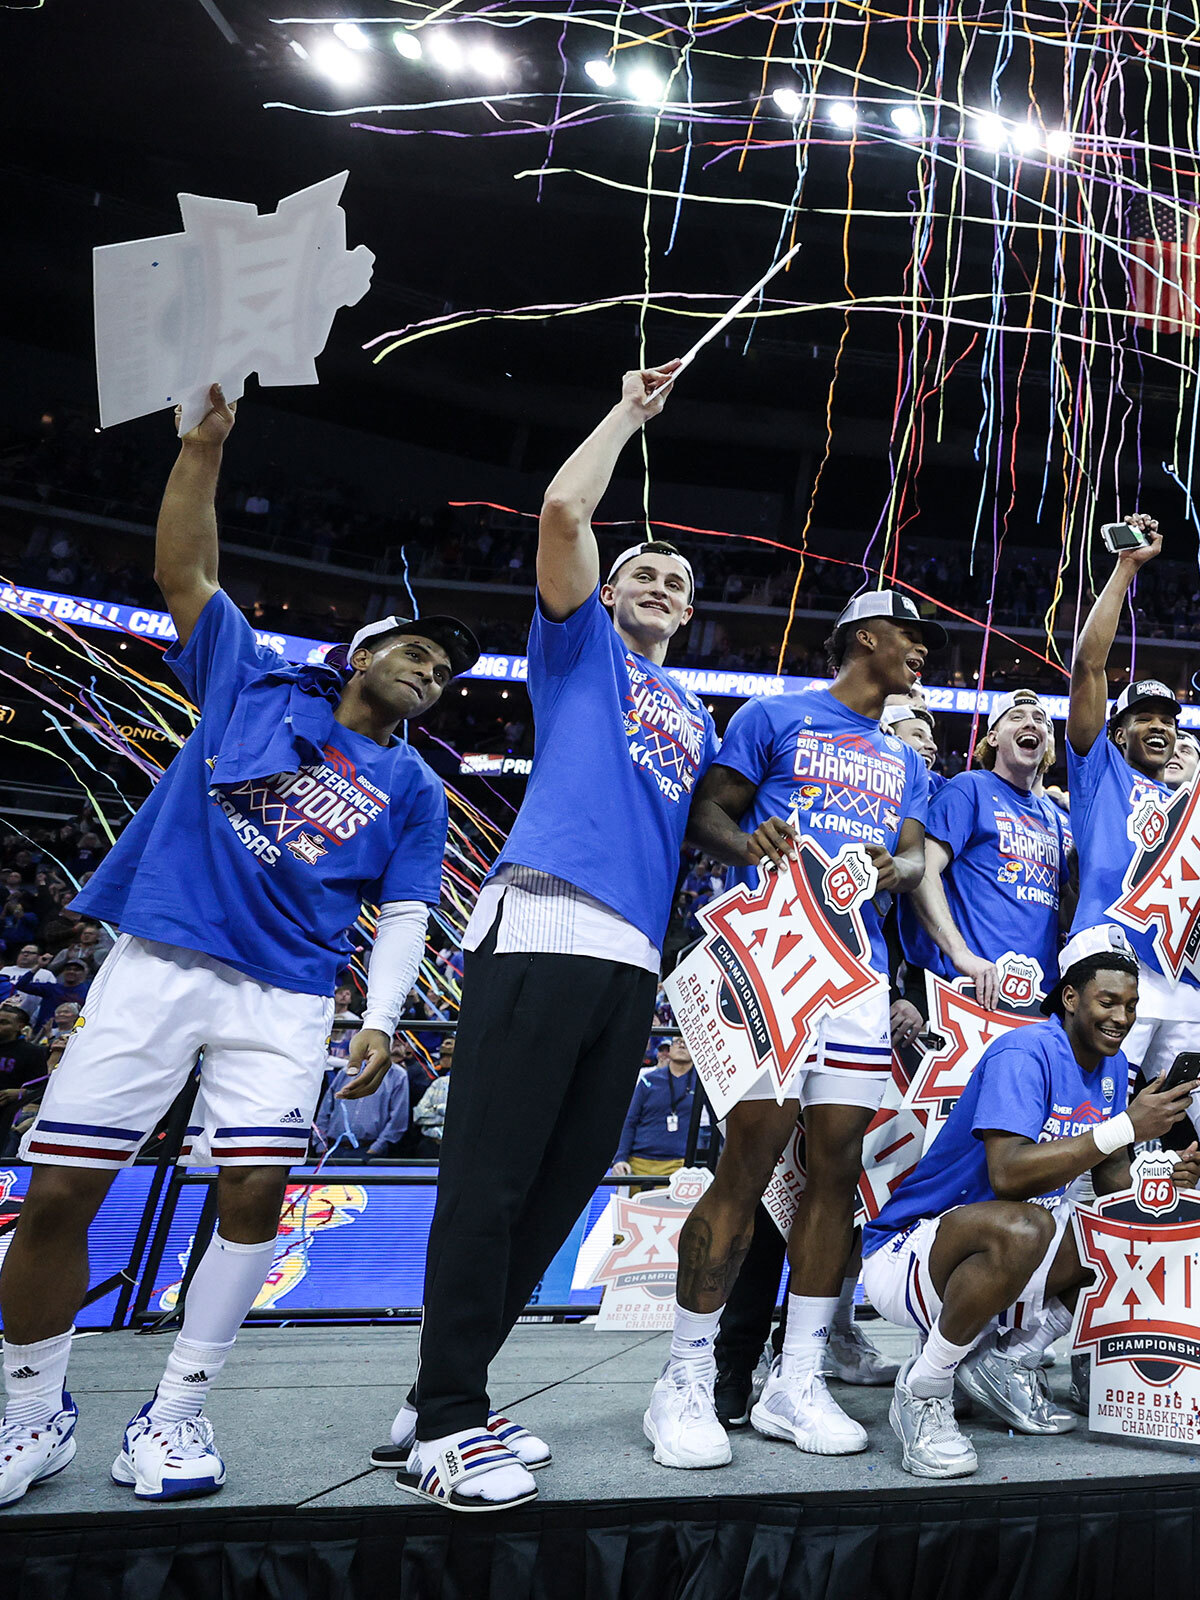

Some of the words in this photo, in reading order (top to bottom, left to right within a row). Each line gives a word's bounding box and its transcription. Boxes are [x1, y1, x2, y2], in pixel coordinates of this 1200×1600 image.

[471, 655, 509, 677] BIG
[956, 690, 989, 711] BIG
[796, 737, 819, 751] BIG
[822, 741, 835, 756] 12
[837, 747, 907, 783] CONFERENCE
[793, 748, 906, 804] CHAMPIONS
[356, 774, 391, 805] BASKETBALL
[264, 771, 369, 841] MPIONS
[1136, 804, 1155, 831] PHILLIPS
[1144, 814, 1165, 841] 66
[846, 856, 867, 888] PHILLIPS
[830, 870, 855, 900] 66
[721, 855, 857, 1053] XII
[1007, 963, 1033, 978] PHILLIPS
[716, 944, 767, 1046] CHAMPIONSHIP
[1004, 980, 1030, 997] 66
[675, 975, 696, 1017] MEN'S
[693, 1016, 731, 1097] BASKETBALL
[688, 973, 710, 1017] 2022
[707, 1019, 725, 1052] BIG
[722, 1056, 737, 1079] 12
[676, 1007, 713, 1083] CHAMPIONS
[1142, 1166, 1171, 1177] PHILLIPS
[677, 1184, 700, 1197] 66
[1143, 1181, 1171, 1203] 66
[624, 1272, 678, 1283] CHAMPIO
[606, 1313, 638, 1321] MEN'S
[641, 1312, 675, 1321] BASKE
[615, 1303, 651, 1312] 2022
[625, 1320, 674, 1329] CHAMPIO
[1097, 1403, 1134, 1420] MEN'S
[1105, 1389, 1147, 1406] 2022
[1152, 1392, 1183, 1410] BIG
[1121, 1419, 1195, 1441] CHAMPIONS
[445, 1450, 460, 1477] adidas
